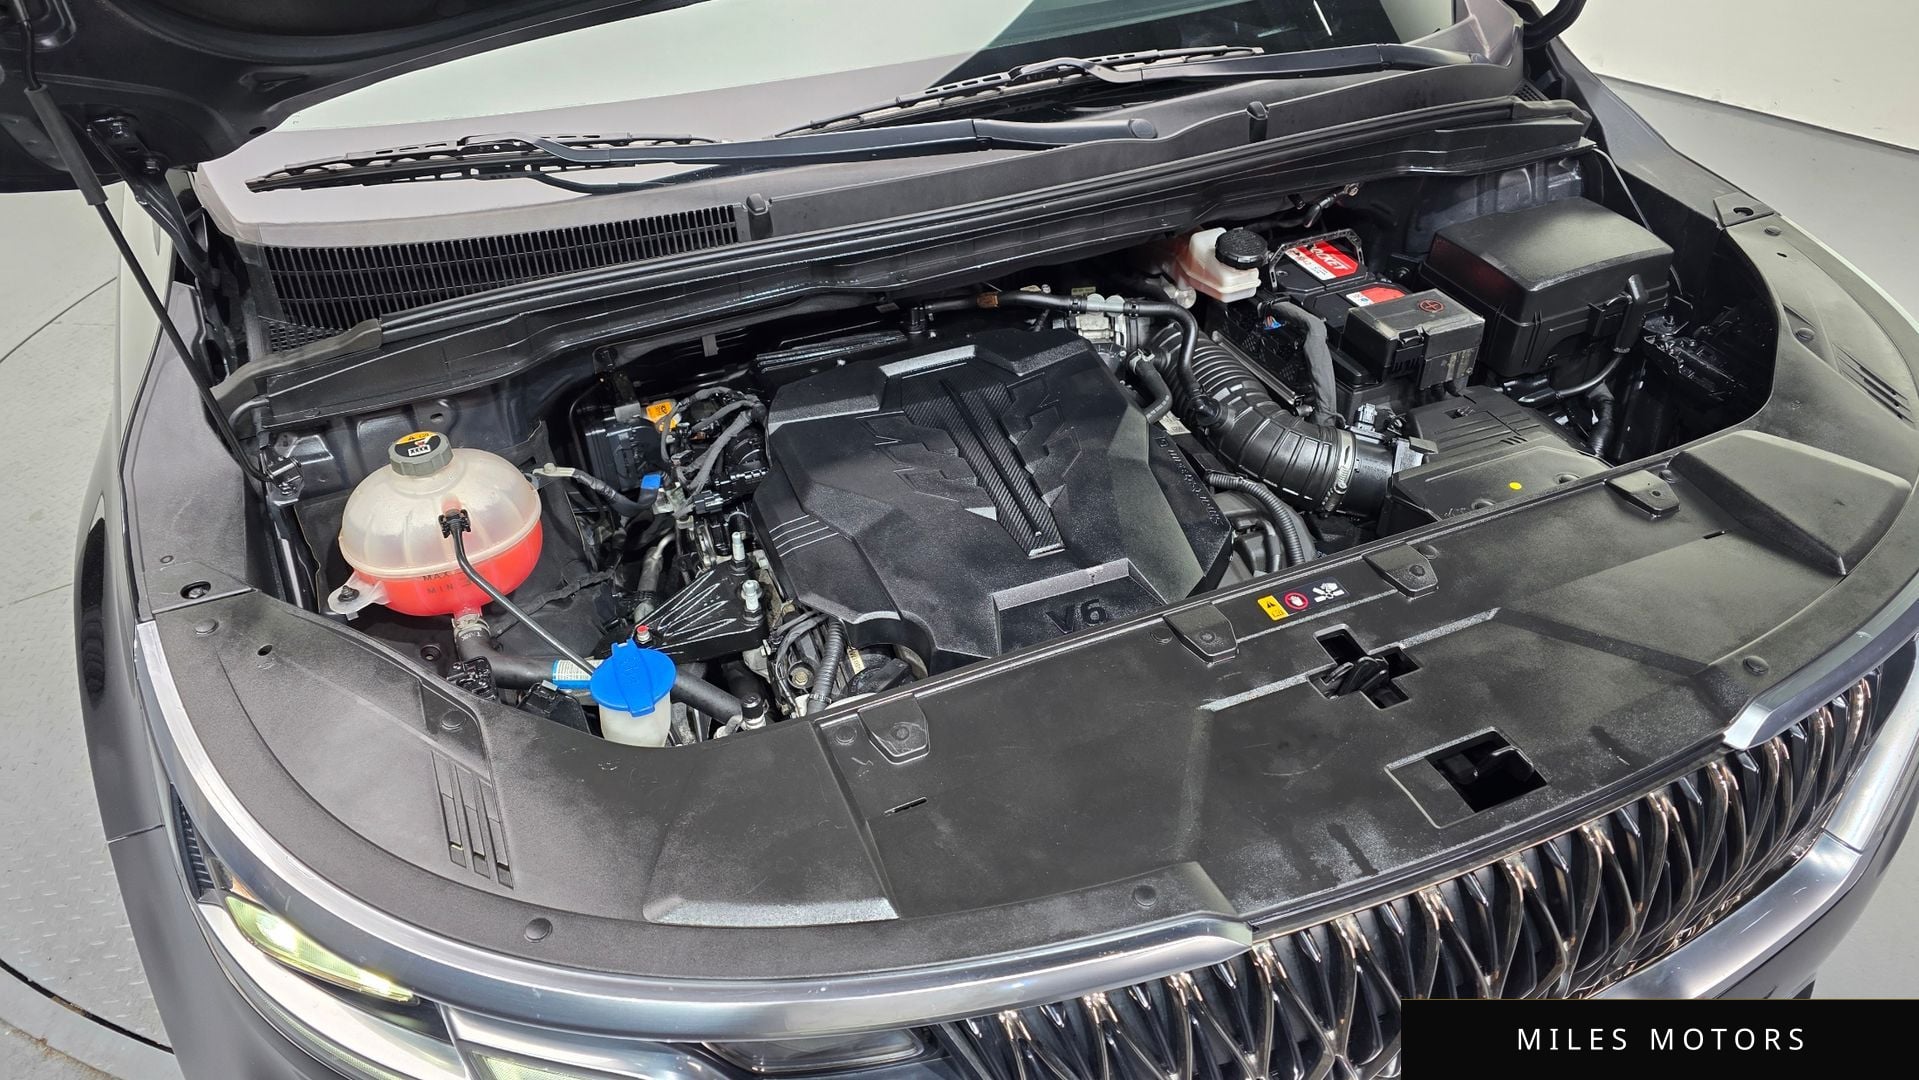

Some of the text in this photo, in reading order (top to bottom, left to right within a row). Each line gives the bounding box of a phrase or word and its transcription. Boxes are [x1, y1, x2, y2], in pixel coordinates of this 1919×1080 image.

[422, 571, 449, 581] MAX
[427, 584, 453, 594] MIN
[1044, 599, 1107, 634] V6
